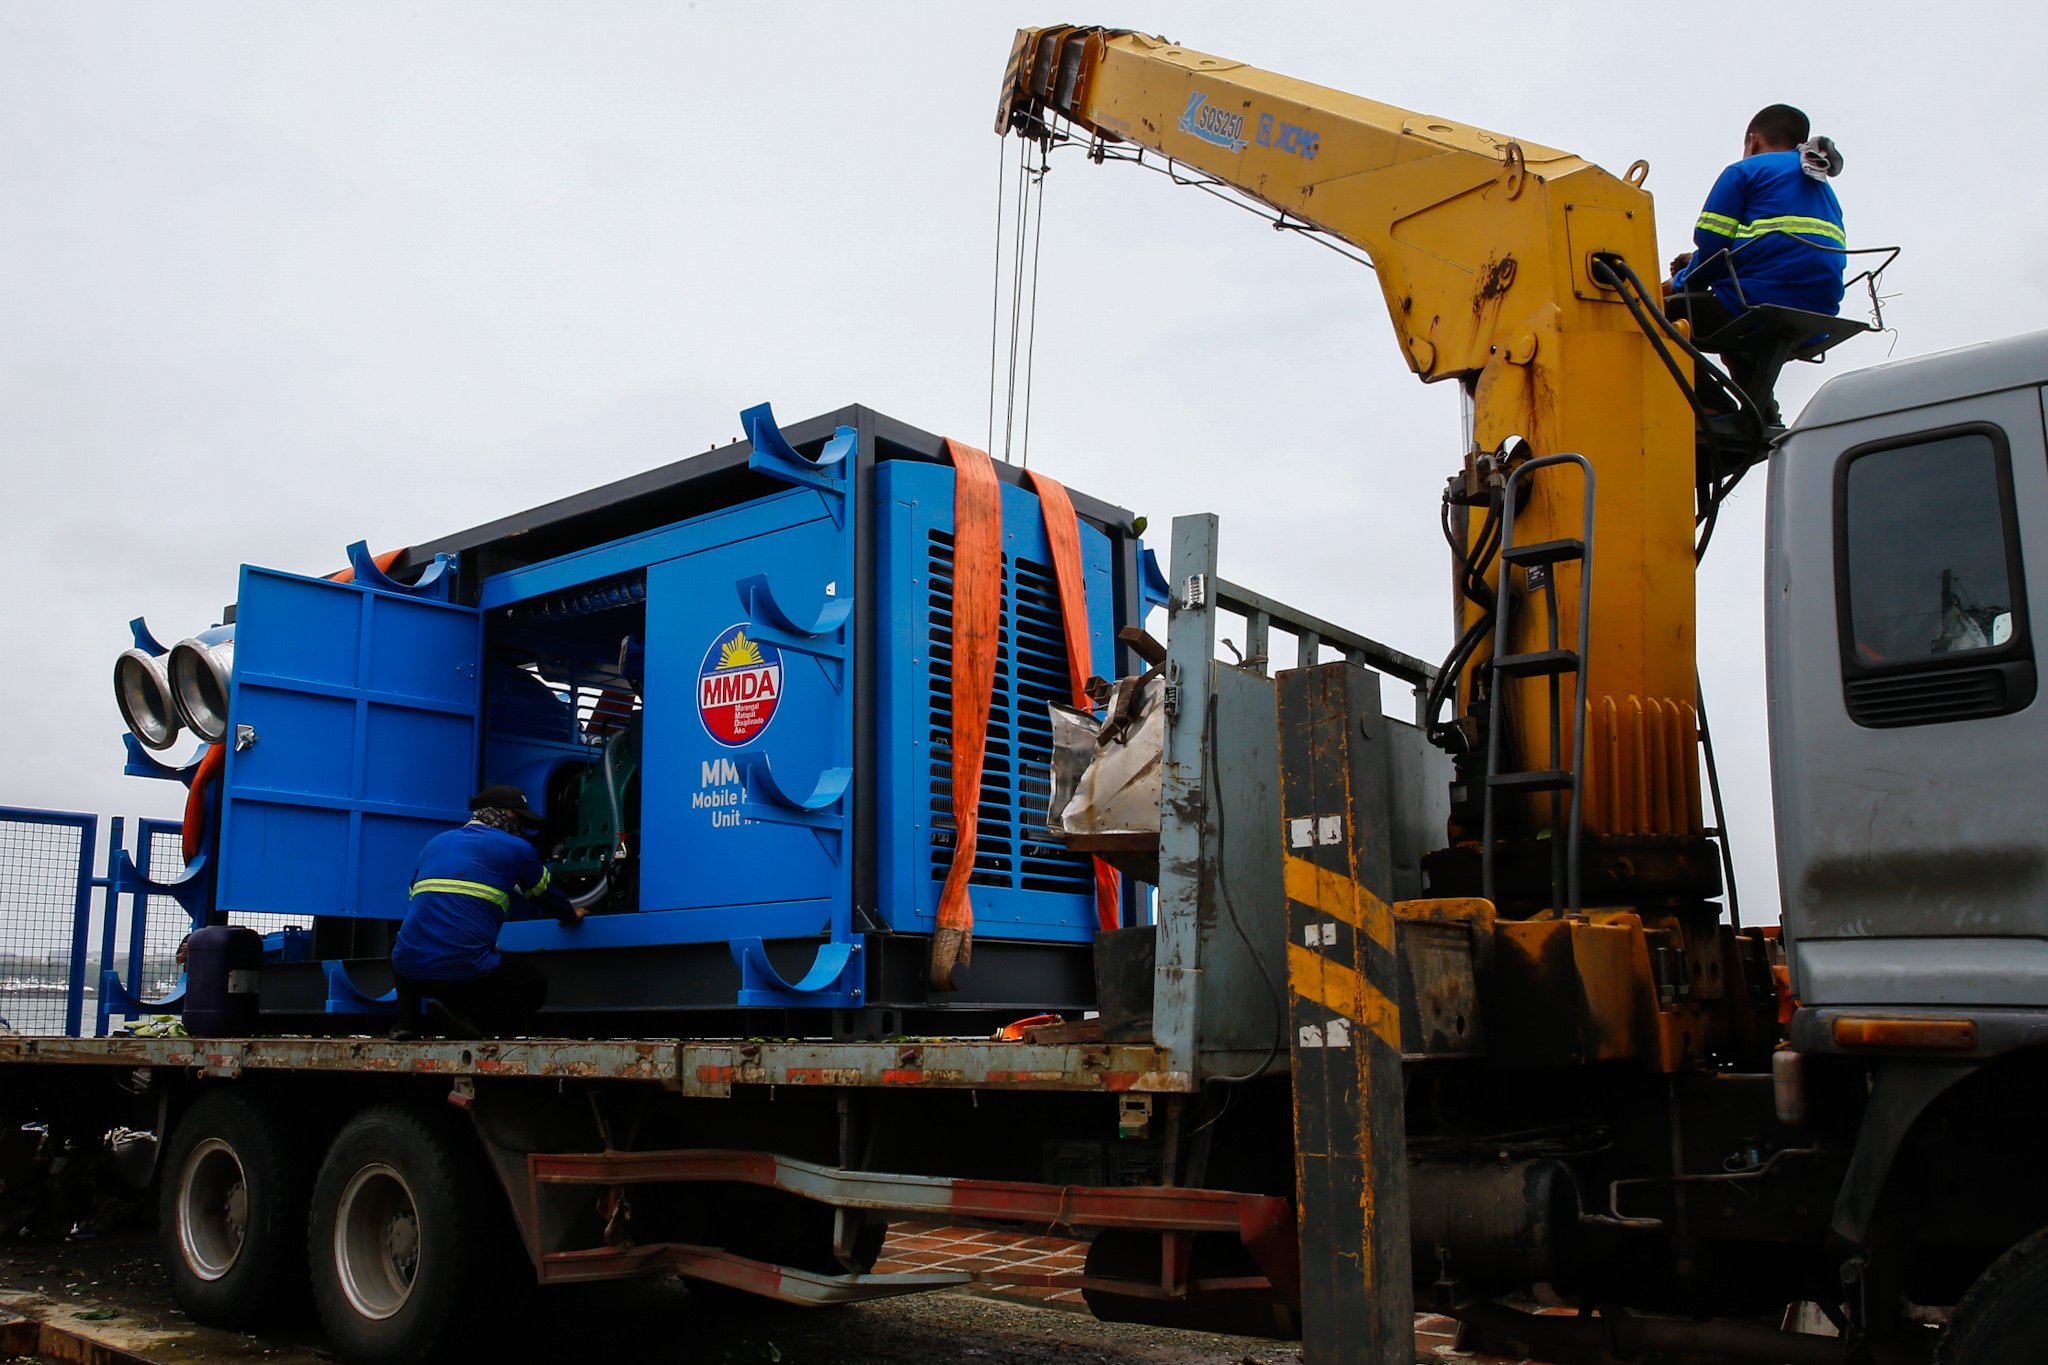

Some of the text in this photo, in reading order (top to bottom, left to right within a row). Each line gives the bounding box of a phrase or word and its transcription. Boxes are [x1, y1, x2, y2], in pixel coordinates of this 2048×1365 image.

[1200, 104, 1243, 141] SQS250
[703, 670, 775, 706] MMDA
[735, 702, 760, 712] Marangal
[735, 711, 756, 720] Matapat
[734, 717, 764, 727] Disiplinado
[702, 758, 740, 788] MM
[692, 789, 738, 809] Mobile
[712, 809, 741, 828] Unit
